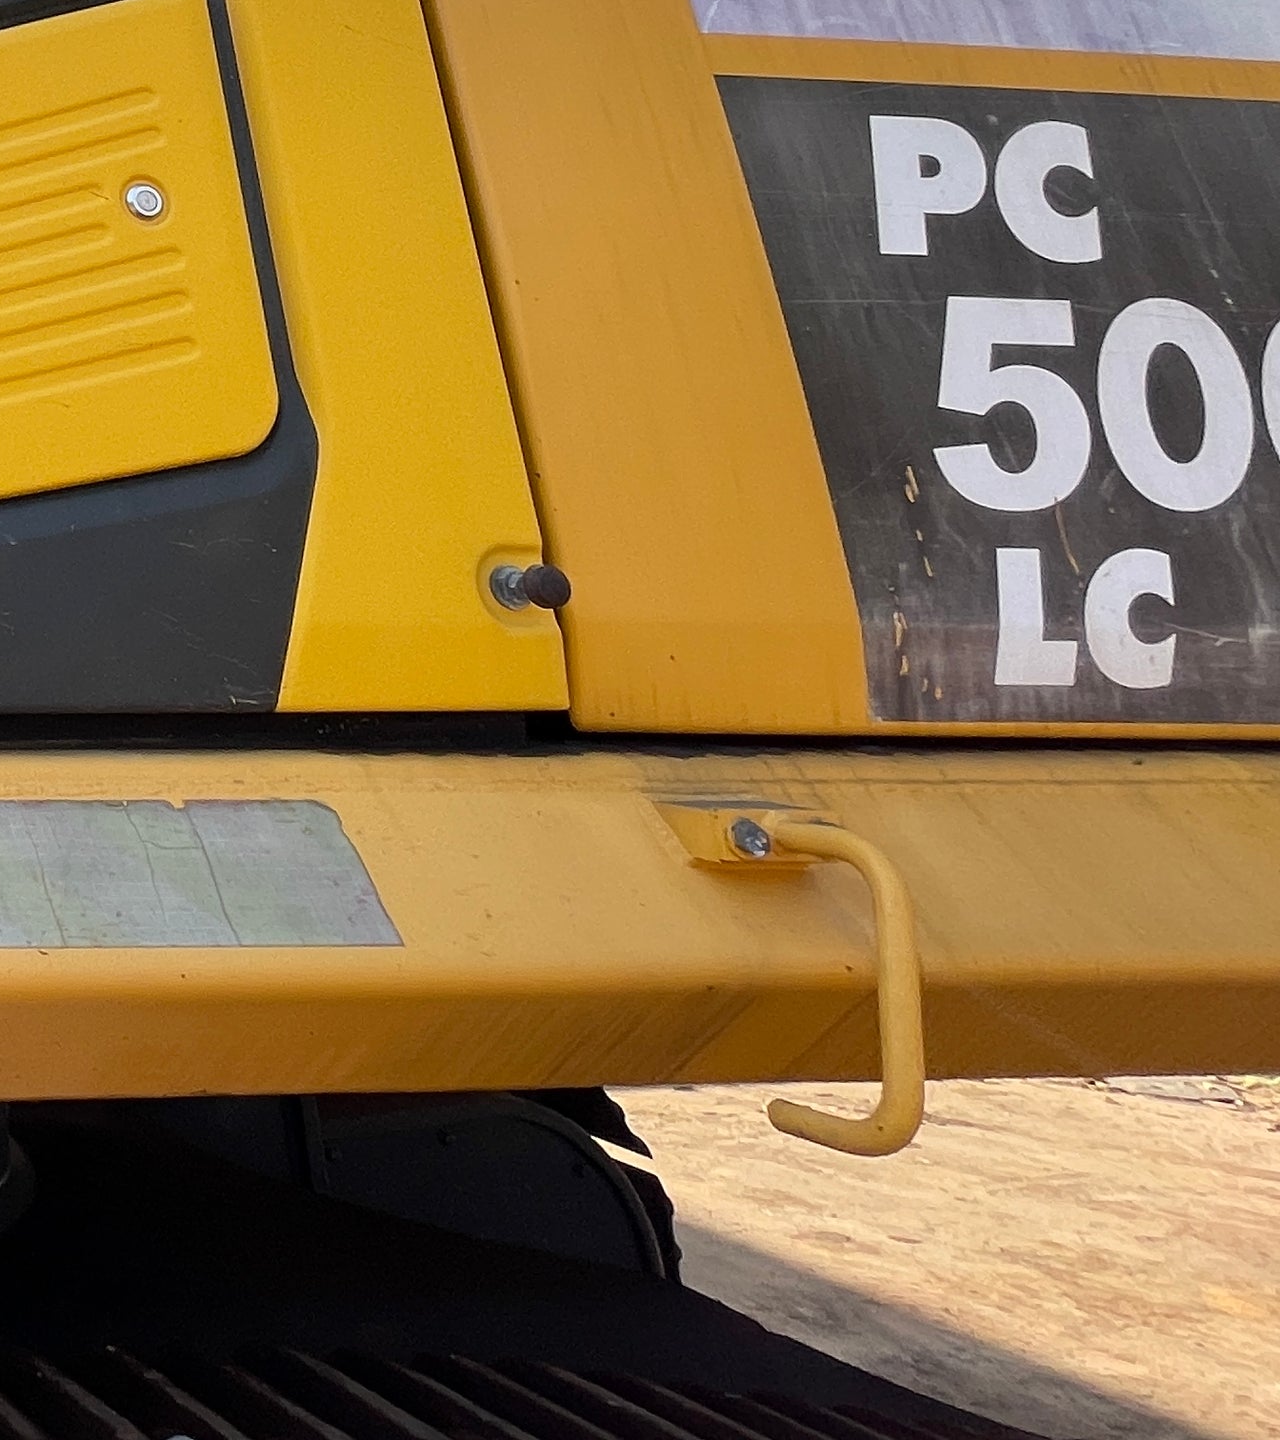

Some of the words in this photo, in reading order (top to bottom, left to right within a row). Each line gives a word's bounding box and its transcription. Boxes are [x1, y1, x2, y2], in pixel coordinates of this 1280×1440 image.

[869, 114, 1102, 264] PC
[932, 296, 1280, 513] 50
[994, 547, 1177, 690] LC
